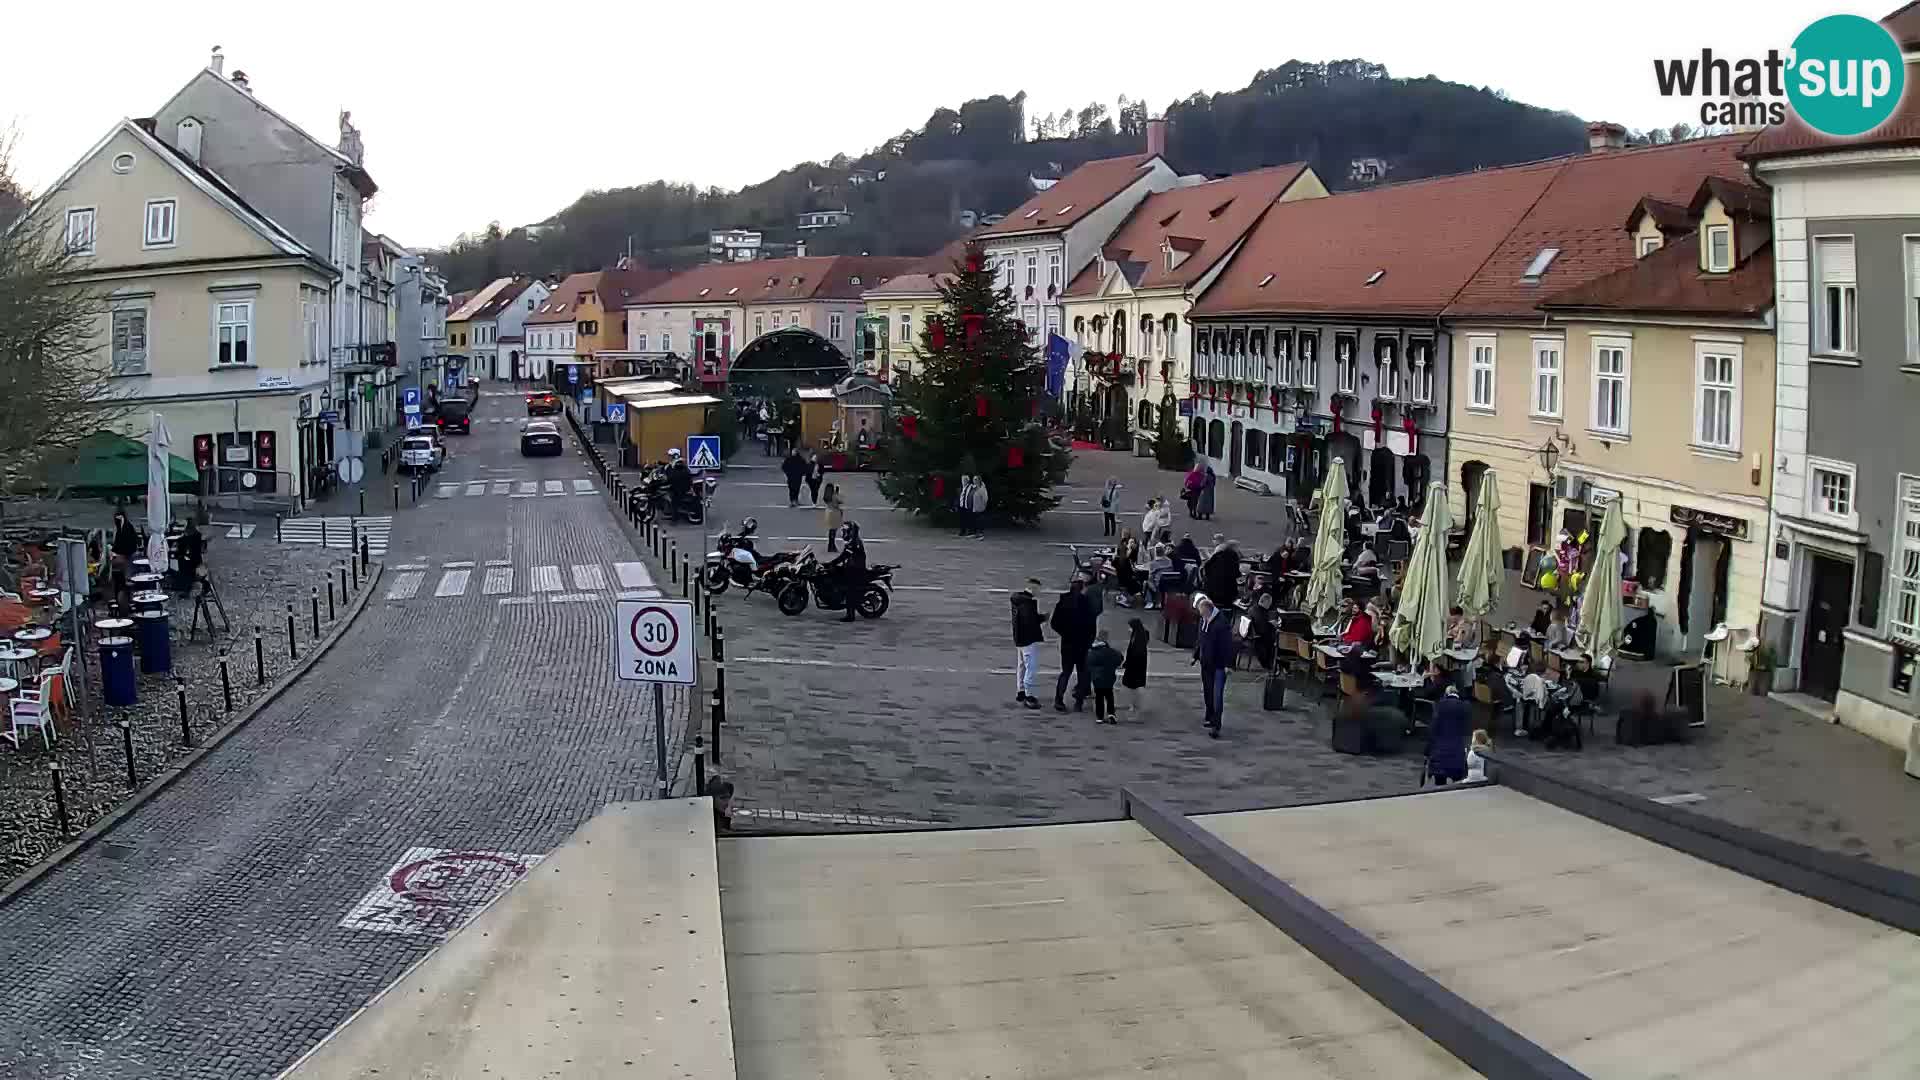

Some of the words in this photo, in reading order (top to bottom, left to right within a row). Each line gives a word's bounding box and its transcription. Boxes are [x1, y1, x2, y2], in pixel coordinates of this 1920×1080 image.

[407, 391, 416, 403] P
[643, 622, 668, 643] 30
[633, 659, 678, 676] ZONA
